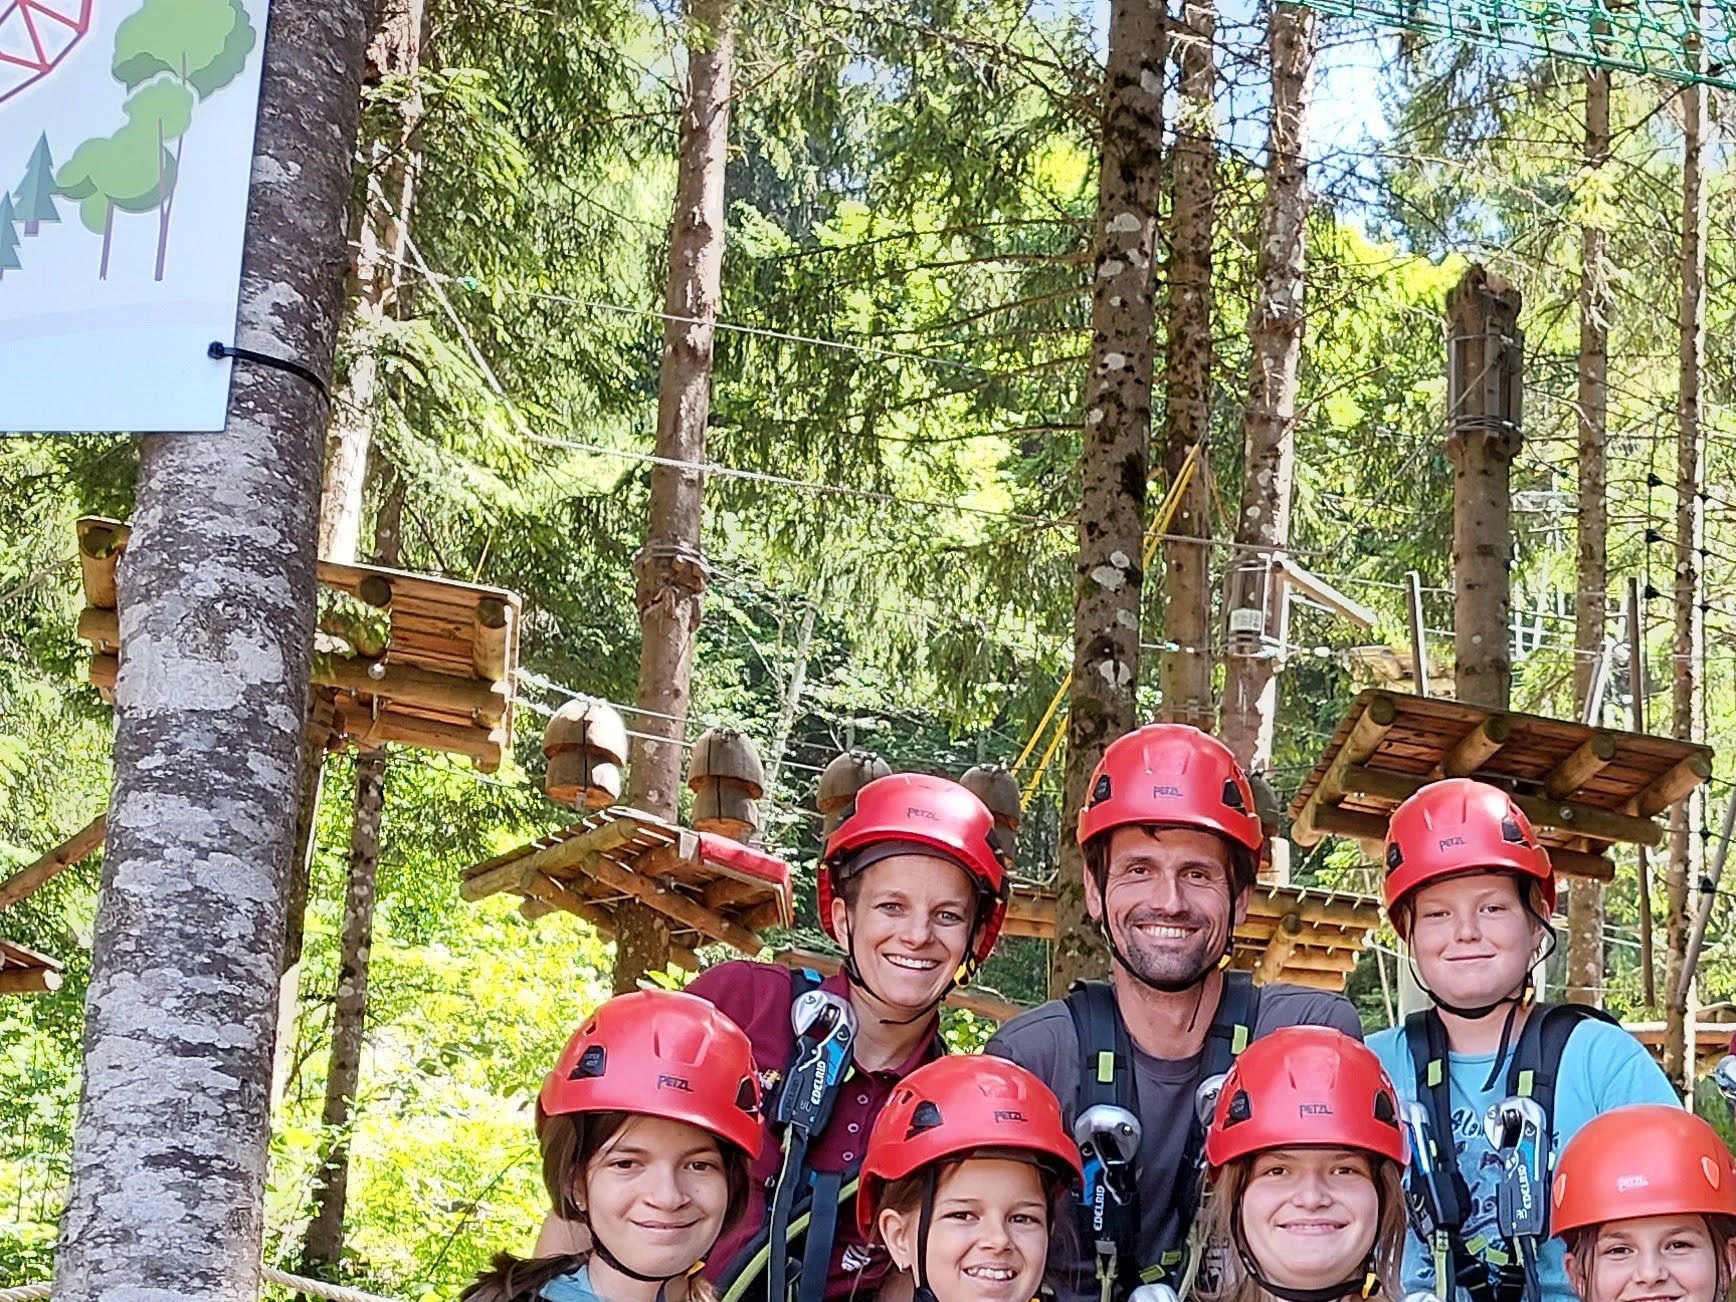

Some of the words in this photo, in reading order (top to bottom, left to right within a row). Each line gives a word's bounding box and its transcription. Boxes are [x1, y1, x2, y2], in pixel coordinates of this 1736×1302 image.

[1153, 786, 1184, 799] PETZL
[1438, 837, 1467, 852] PETZL
[657, 1075, 695, 1093] PETZL
[810, 1060, 827, 1105] EDELRID
[993, 1111, 1029, 1123] PETZL
[1299, 1105, 1334, 1118] PETZL
[1093, 1185, 1105, 1232] EDELRID
